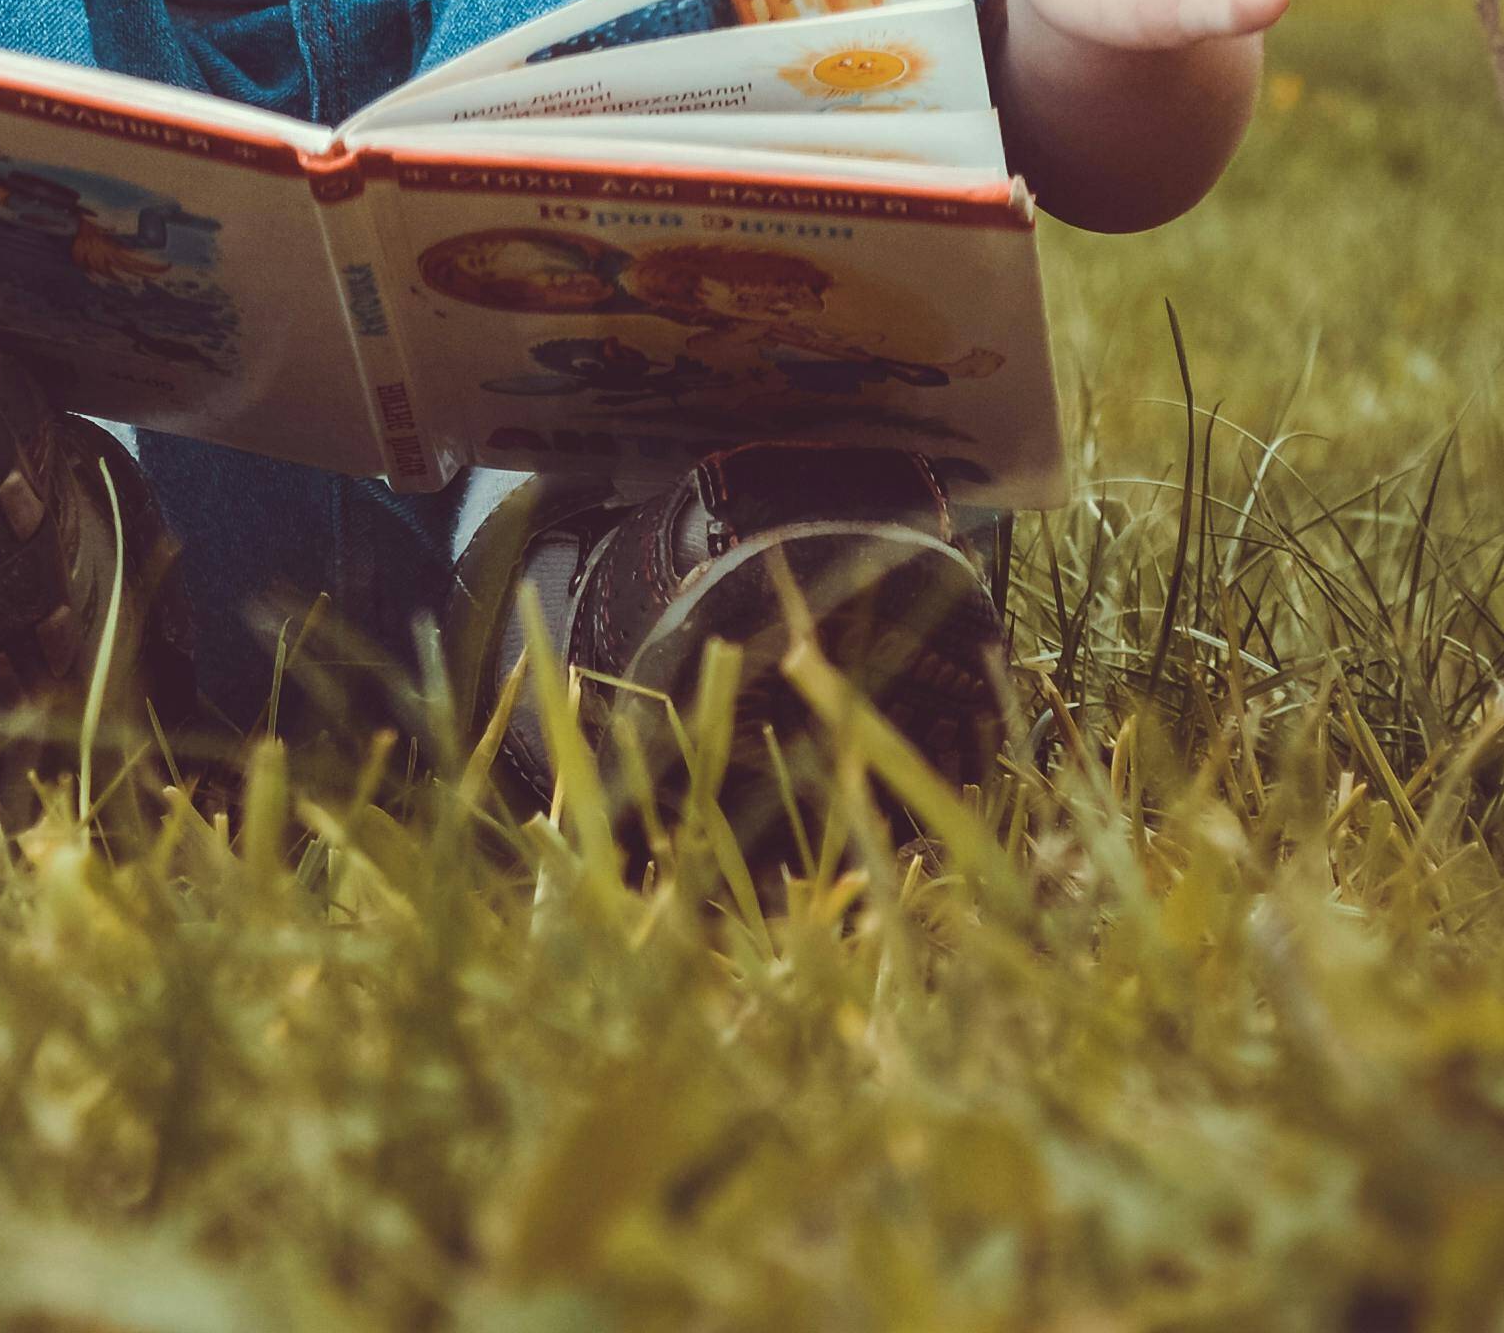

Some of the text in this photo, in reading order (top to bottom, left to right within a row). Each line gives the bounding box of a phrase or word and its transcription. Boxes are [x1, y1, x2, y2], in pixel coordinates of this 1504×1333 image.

[19, 95, 212, 153] МАЛЫШЕЙ
[448, 171, 910, 215] СТИХИ ДЛЯ МАЛЫШЕЙ
[538, 203, 685, 229] Юрий
[377, 382, 428, 477] ЮРИЙ ЭНТИН
